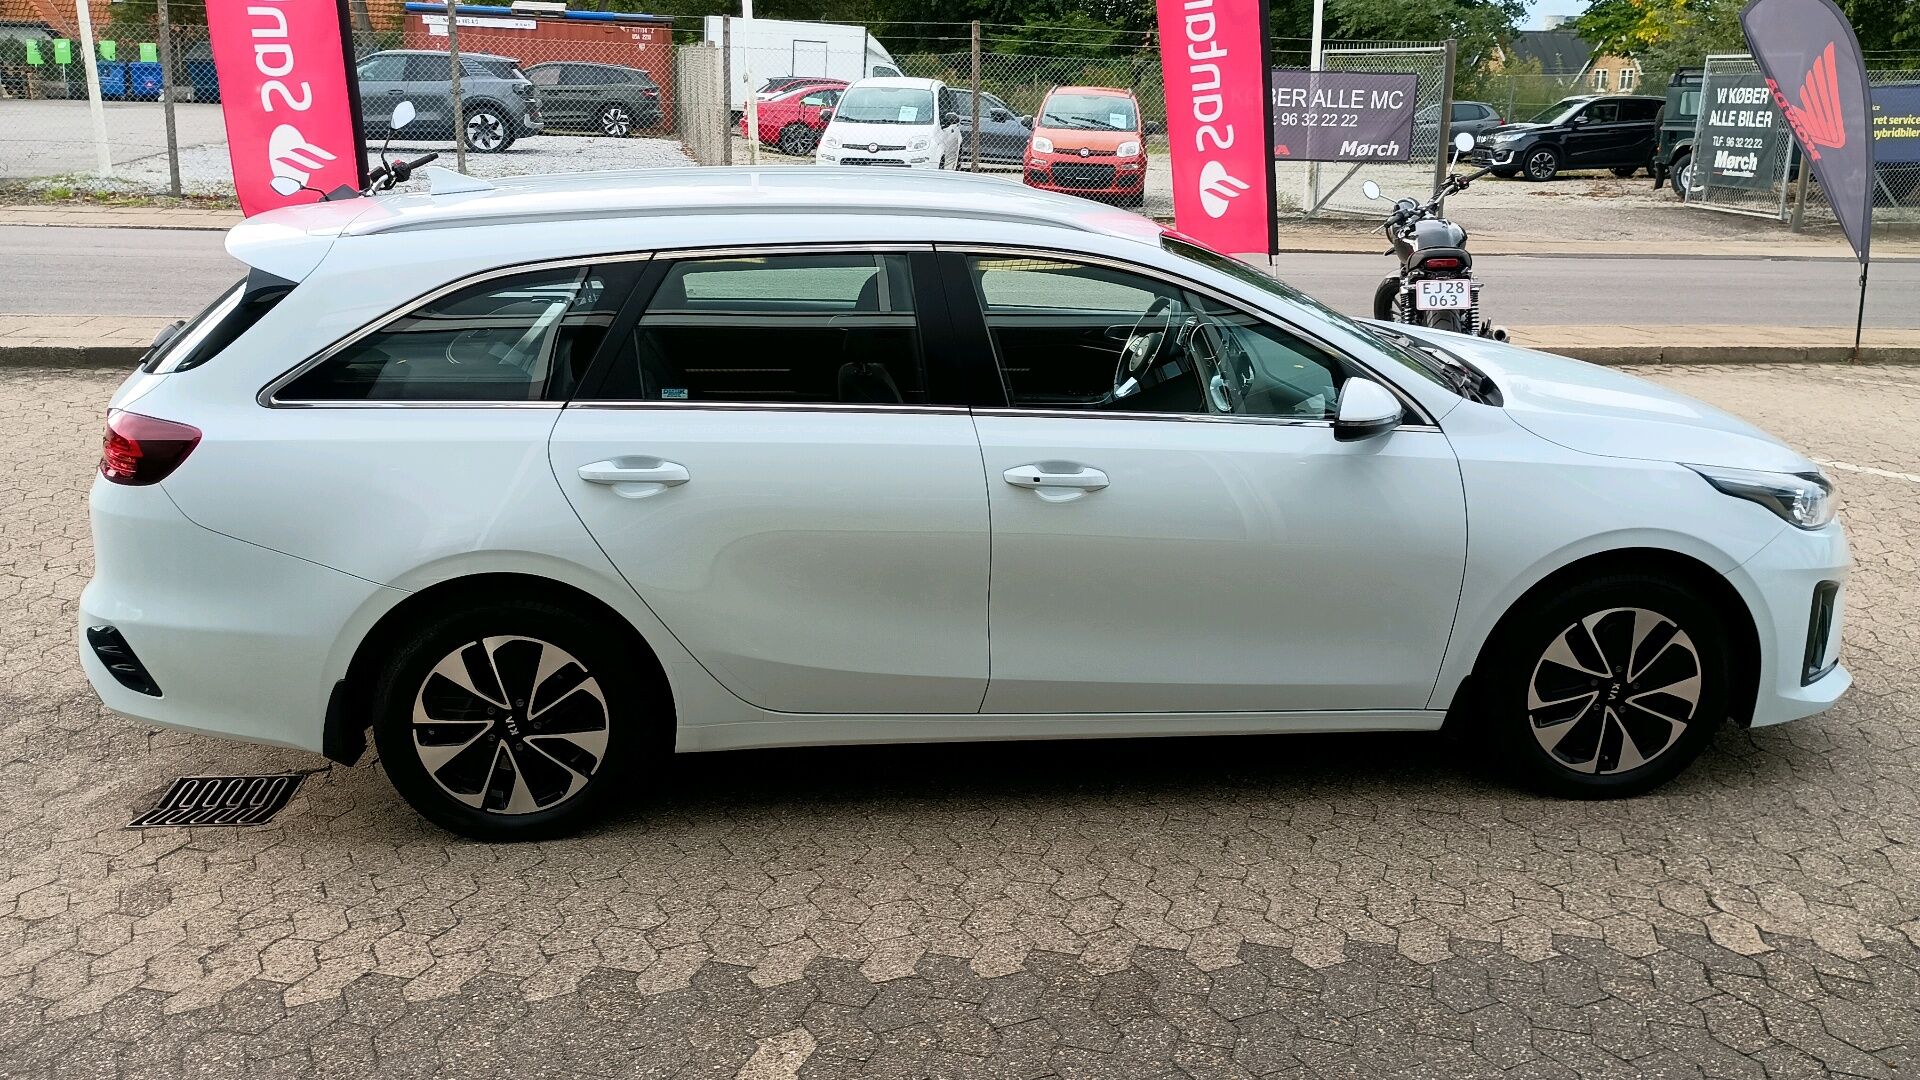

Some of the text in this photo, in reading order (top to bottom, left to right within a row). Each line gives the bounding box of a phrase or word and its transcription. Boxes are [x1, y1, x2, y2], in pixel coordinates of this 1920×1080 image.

[1311, 88, 1365, 109] ALLE
[1370, 90, 1404, 110] MC
[1717, 87, 1770, 104] VI KØBER
[1281, 112, 1298, 126] 96
[1301, 113, 1318, 127] 32
[1321, 113, 1338, 127] 22
[1341, 114, 1358, 127] 22
[1708, 109, 1773, 128] ALLE BILER
[1873, 114, 1920, 125] ret service
[1339, 140, 1400, 157] Mørch
[1726, 136, 1735, 147] 96
[1735, 137, 1744, 148] 32
[1744, 138, 1753, 148] 22
[1753, 138, 1763, 149] 22
[1713, 150, 1758, 171] Mørch
[1429, 295, 1458, 307] 063
[1608, 682, 1621, 700] KIA
[505, 715, 520, 736] KIA
